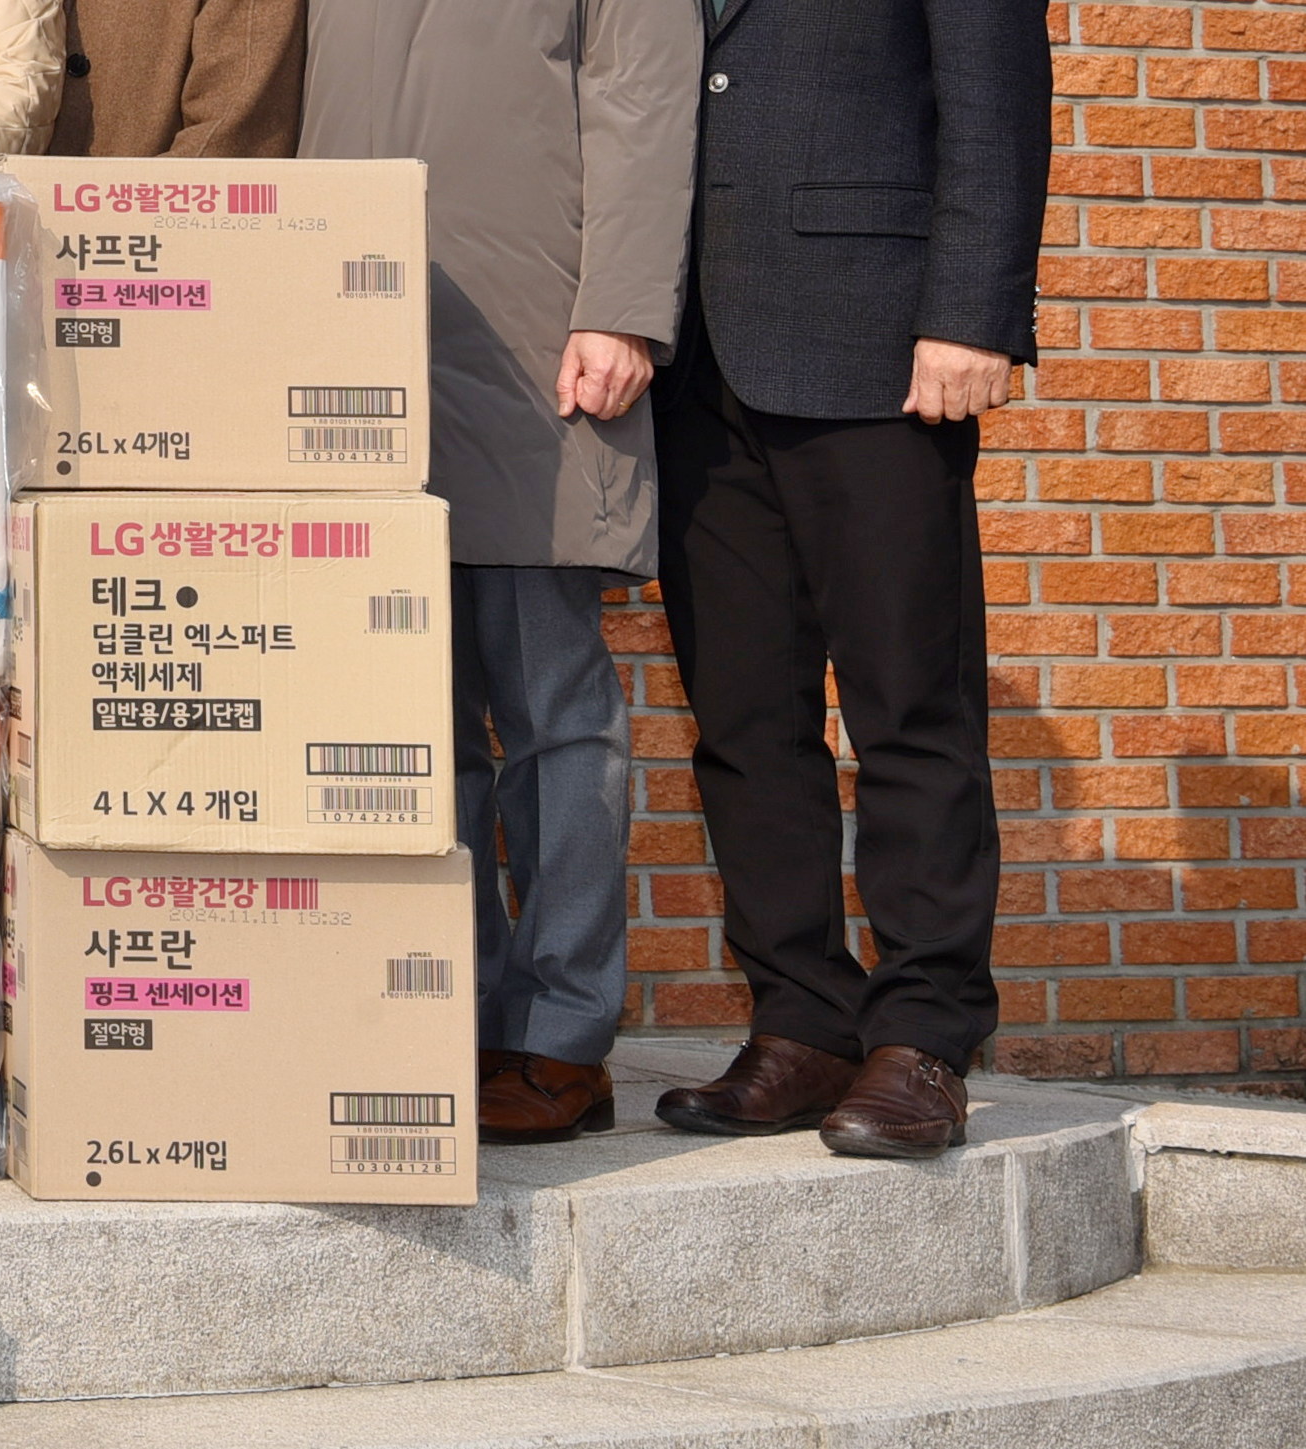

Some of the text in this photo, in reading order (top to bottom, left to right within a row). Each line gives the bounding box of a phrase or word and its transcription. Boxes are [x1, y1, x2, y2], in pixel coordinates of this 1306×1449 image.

[53, 183, 220, 214] LG 생활건강
[154, 216, 328, 232] 2024.12.02 14:38
[56, 233, 162, 273] 샤프란
[60, 283, 207, 308] 핑크 센세이션
[61, 322, 114, 344] 절약형
[91, 522, 284, 557] LG 생활건강
[92, 577, 166, 616] 테크
[93, 624, 296, 655] 딥클린 엑스퍼트
[92, 662, 202, 692] 액체세제
[83, 877, 258, 908] LG 생활건강
[170, 909, 352, 925] 2024.11.11 15:32
[85, 929, 196, 970] 샤프란
[90, 981, 243, 1007] 핑크 센세이션
[91, 1022, 146, 1046] 절약형
[166, 1141, 227, 1171] 4개입
